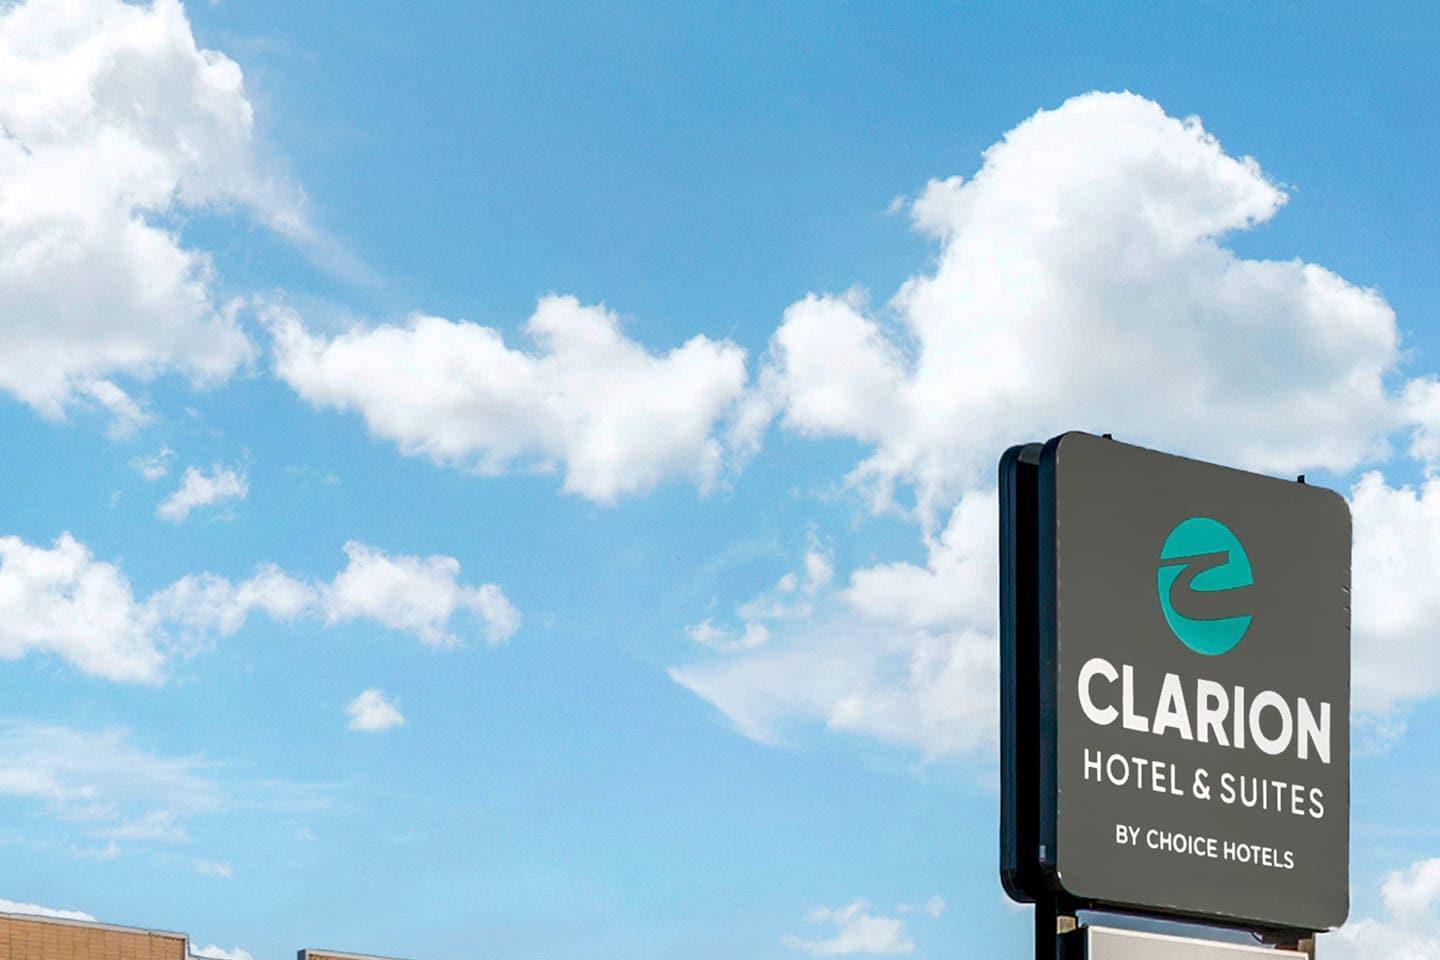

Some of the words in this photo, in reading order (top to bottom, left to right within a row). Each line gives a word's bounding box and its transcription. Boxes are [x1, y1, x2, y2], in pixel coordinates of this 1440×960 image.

[1077, 657, 1331, 765] CLARION
[1083, 747, 1184, 797] HOTEL
[1192, 768, 1211, 801] &
[1220, 772, 1325, 819] SUITES
[1115, 824, 1141, 847] BY
[1146, 828, 1218, 858] CHOICE
[1223, 842, 1294, 869] HOTELS
